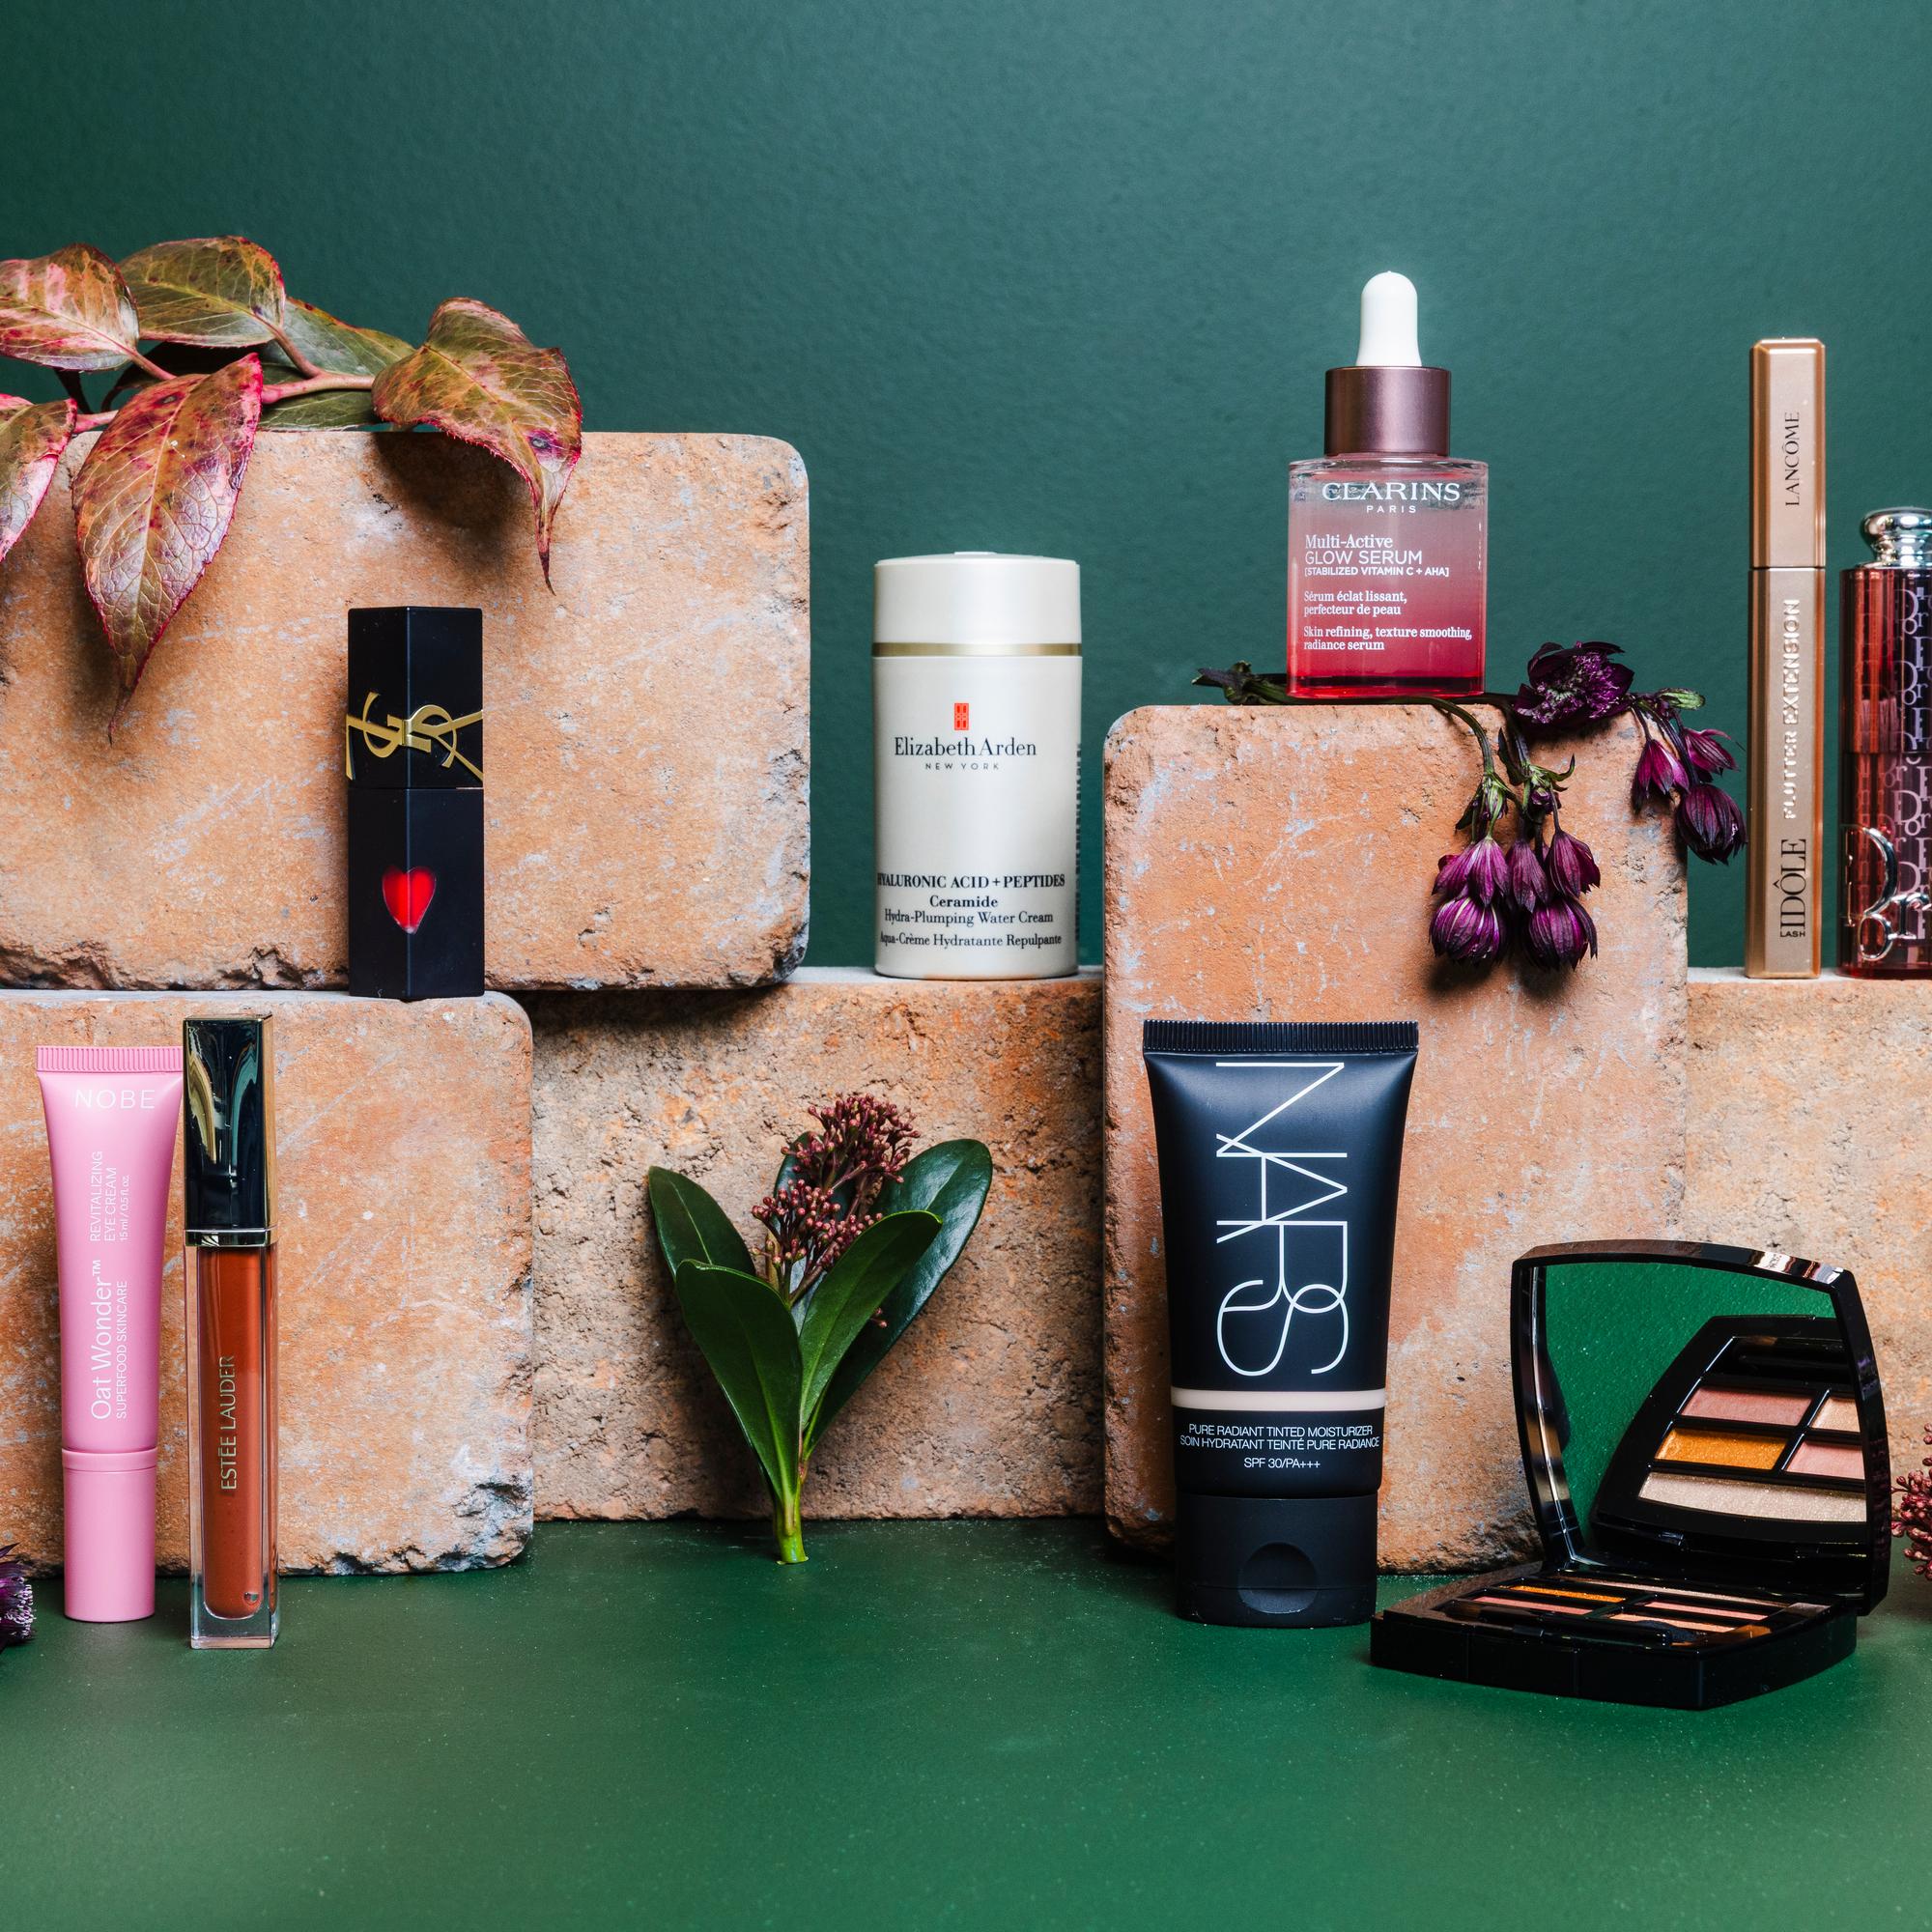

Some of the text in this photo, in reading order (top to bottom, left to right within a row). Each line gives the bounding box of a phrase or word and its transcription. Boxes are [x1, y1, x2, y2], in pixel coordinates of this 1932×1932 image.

[1781, 412, 1801, 506] LANCÔME
[1321, 482, 1461, 501] CLARINS
[1366, 505, 1417, 514] PARIS
[1305, 533, 1394, 549] Multi-Active
[1305, 550, 1423, 565] GLOW SERUM
[1304, 566, 1358, 578] [STABILIZED
[1361, 566, 1404, 577] VITAMIN
[1406, 566, 1414, 577] C
[1424, 566, 1450, 578] AHA]
[1303, 590, 1407, 604] Sérum éclat lissant,
[1303, 604, 1402, 617] perfecteur de peau
[1303, 626, 1473, 639] Skin refining, texture smoothing,
[1303, 639, 1385, 650] radiance serum
[1783, 599, 1801, 819] FLUTTER EXTENSION
[894, 736, 1037, 756] Elizabeth Arden
[925, 762, 1000, 771] NEW YORK
[951, 875, 989, 889] ACID
[991, 877, 1002, 887] +
[1003, 873, 1065, 889] PEPTIDES
[1773, 838, 1807, 929] IDÔLE
[929, 895, 999, 908] Ceramide
[884, 908, 1054, 927] Hydra-Plumping Water Cream
[880, 932, 1063, 950] Aqua-Crème Hydratante Repulpante
[74, 1089, 156, 1110] NOBE
[90, 1151, 103, 1241] REVITALIZING
[104, 1167, 117, 1241] EYE CREAM
[119, 1219, 128, 1231] ml
[1215, 1062, 1349, 1377] NARS
[119, 1232, 128, 1241] 15
[116, 1281, 128, 1419] SUPERFOOD SKINCARE
[91, 1377, 112, 1420] Oat
[219, 1355, 237, 1430] LAUDER
[1188, 1423, 1374, 1438] PURE RADIANT TINTED MOISTURIZER
[1179, 1435, 1380, 1450] SOIN HYDRATANT TEINTÉ PURE RADIANCE
[1243, 1457, 1321, 1469] SPF 30/PA+++
